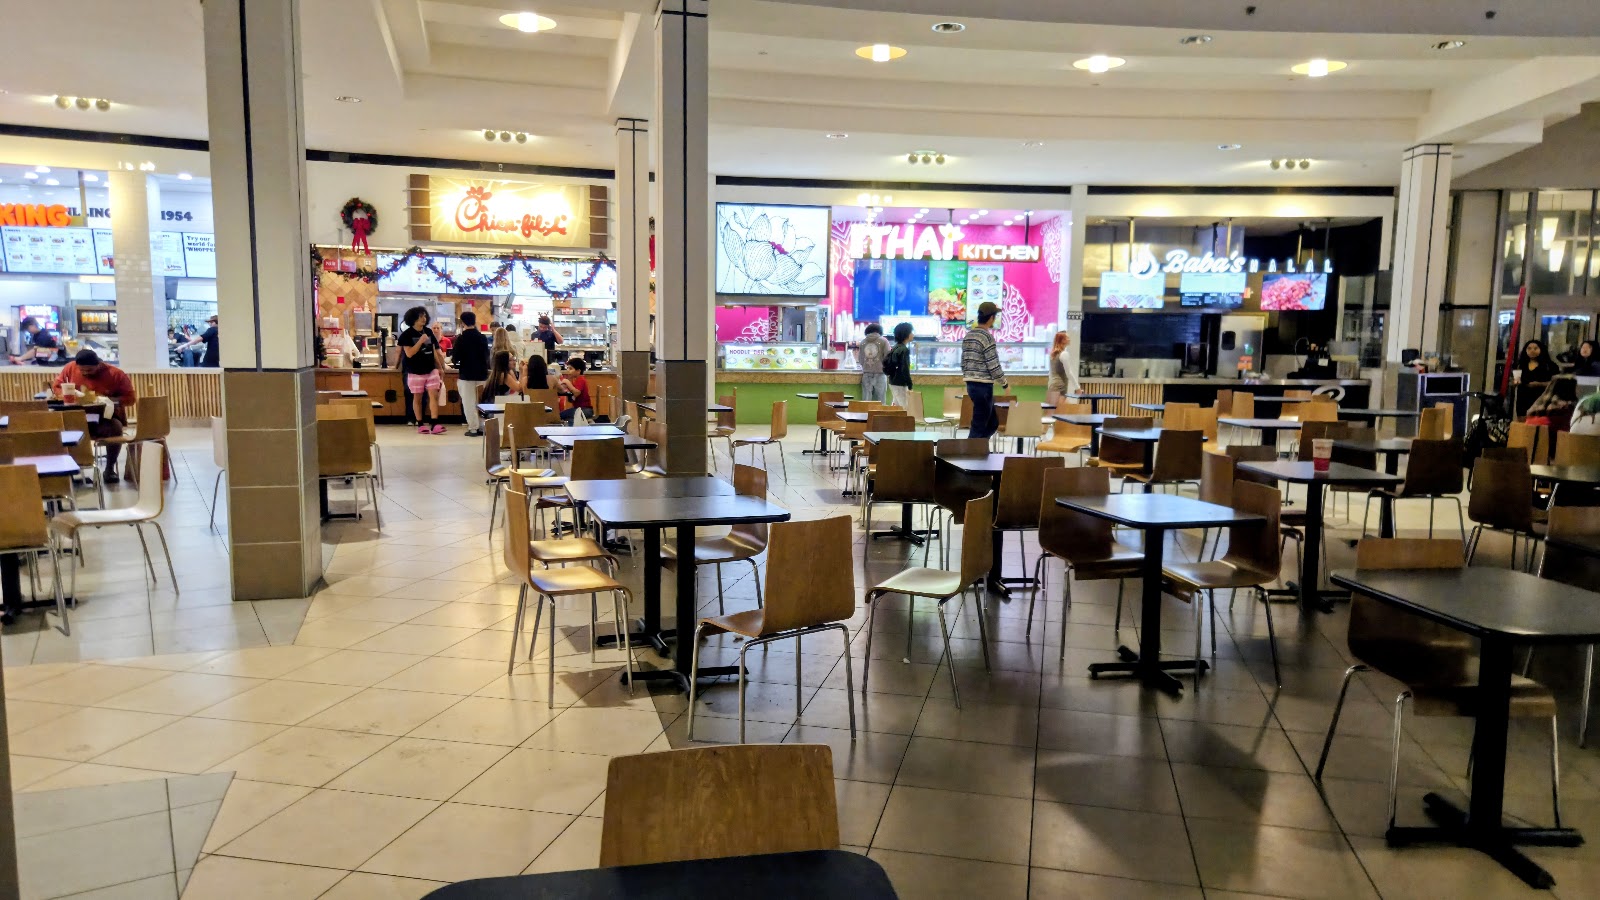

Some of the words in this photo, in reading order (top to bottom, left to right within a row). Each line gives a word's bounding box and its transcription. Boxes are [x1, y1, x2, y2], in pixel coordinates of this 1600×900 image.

[0, 203, 71, 228] KING
[161, 210, 193, 222] 1954
[962, 244, 1040, 261] KITCHEN
[1162, 249, 1246, 274] Baba's
[1249, 258, 1333, 273] HALAL
